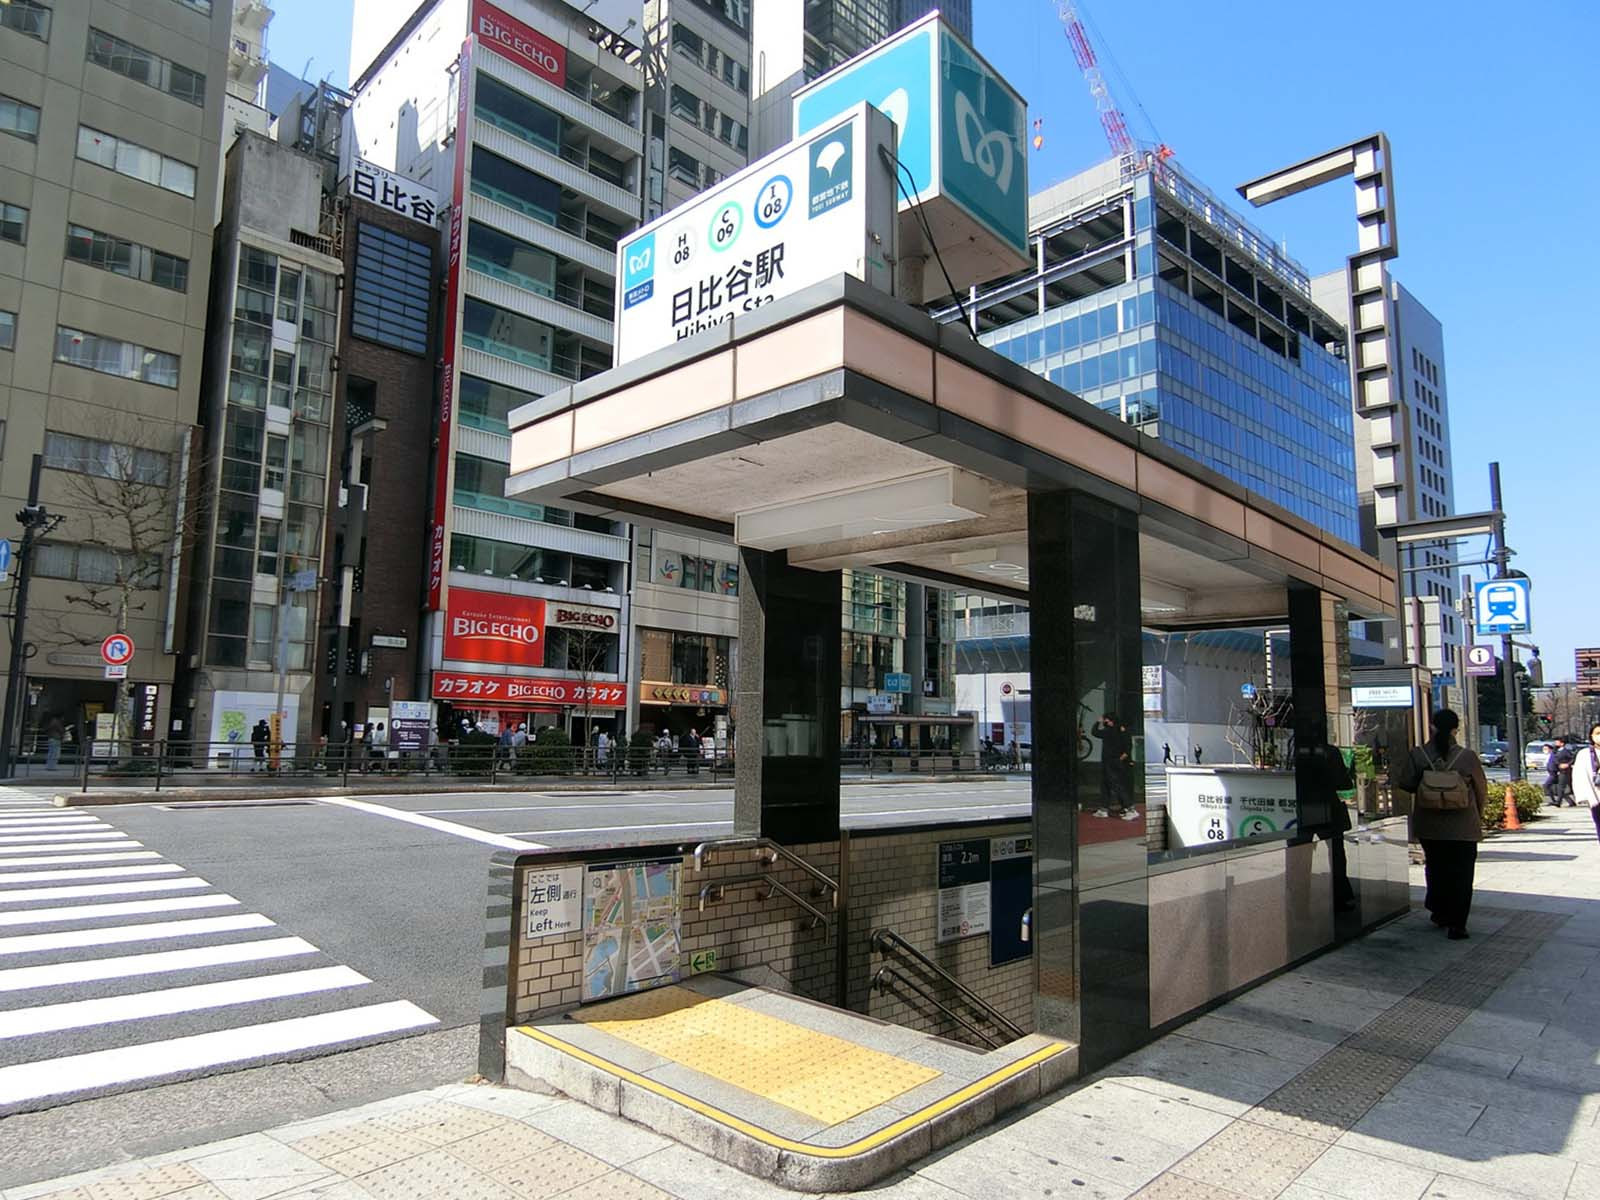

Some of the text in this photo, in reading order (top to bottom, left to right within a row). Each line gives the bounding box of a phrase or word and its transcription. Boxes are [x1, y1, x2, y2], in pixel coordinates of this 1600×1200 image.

[480, 16, 512, 45] BIG
[514, 37, 559, 73] ECHO
[355, 160, 397, 182] ギャラリー
[353, 170, 435, 225] 日比谷
[770, 185, 777, 200] I
[721, 209, 730, 224] C
[763, 198, 783, 219] 08
[450, 205, 462, 267] カラオケ
[678, 233, 687, 248] H
[716, 223, 735, 243] 09
[674, 246, 690, 265] 08
[671, 242, 785, 328] 日比谷駅
[431, 525, 444, 590] カラオケ
[556, 608, 614, 628] BIG ECHO
[453, 617, 539, 644] BIG ECHO
[438, 678, 500, 694] カラオケ
[508, 683, 566, 700] BIG ECHO
[572, 686, 623, 701] カラオケ
[1211, 818, 1220, 828] H
[1254, 821, 1262, 831] C
[1207, 828, 1225, 840] 08
[531, 873, 560, 884] ここでは
[530, 909, 548, 917] Keep
[530, 918, 571, 933] Left Here
